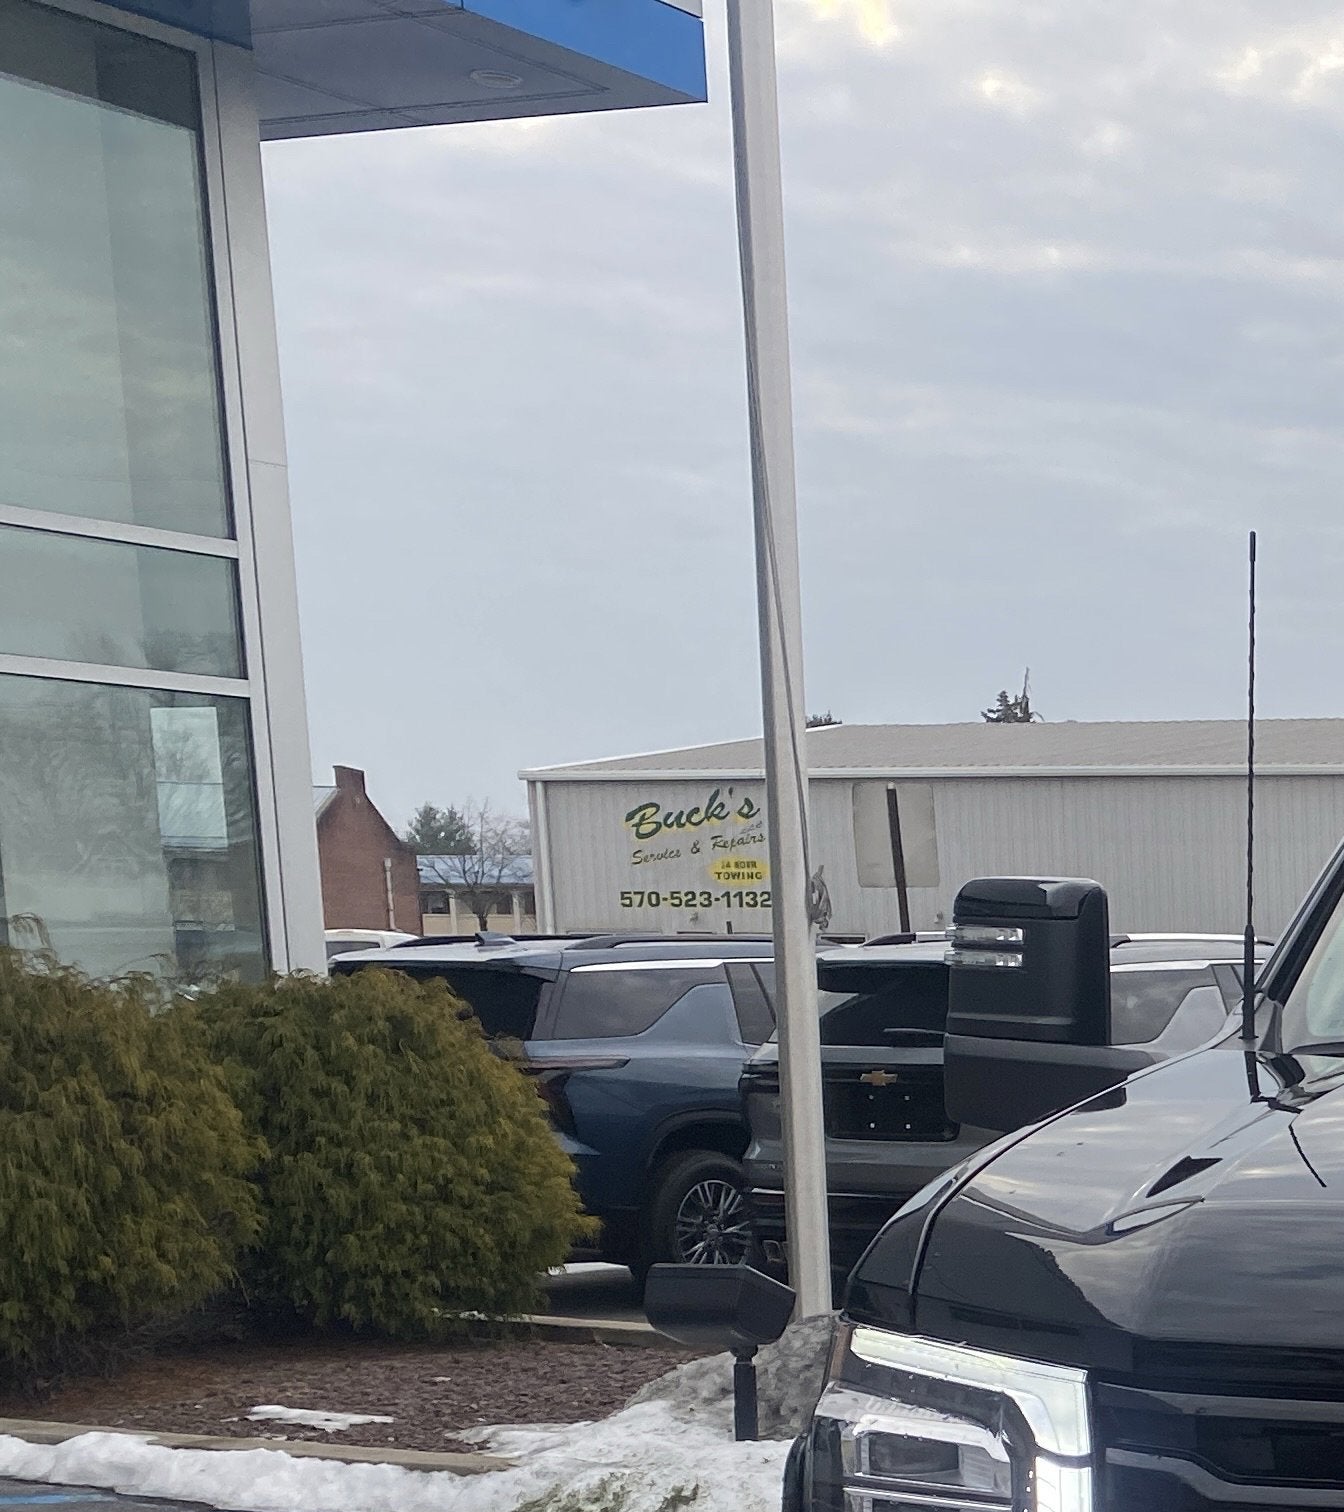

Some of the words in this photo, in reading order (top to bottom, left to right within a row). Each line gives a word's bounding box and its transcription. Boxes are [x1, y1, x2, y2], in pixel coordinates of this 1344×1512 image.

[625, 787, 761, 839] Buck's
[632, 849, 682, 865] Service
[690, 840, 700, 854] &
[711, 832, 766, 851] Repairs
[714, 872, 763, 880] TOWING
[620, 890, 772, 908] 570-523-1132
